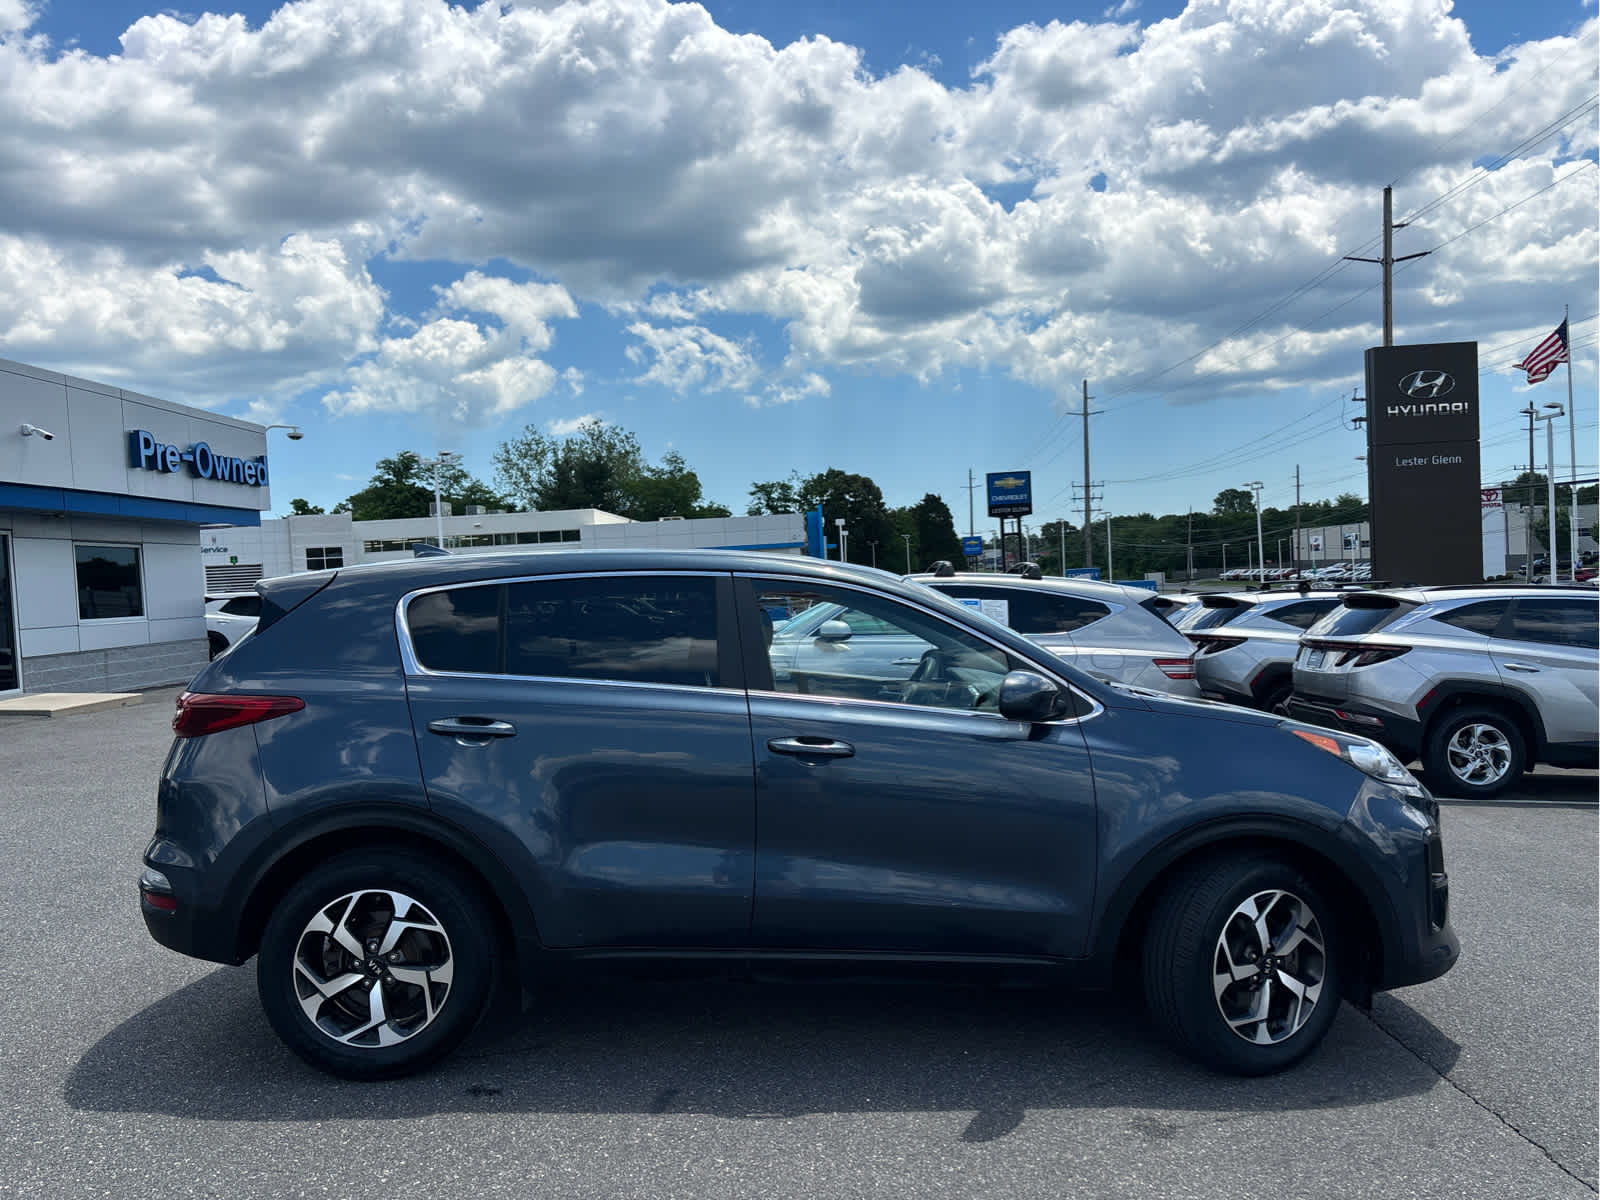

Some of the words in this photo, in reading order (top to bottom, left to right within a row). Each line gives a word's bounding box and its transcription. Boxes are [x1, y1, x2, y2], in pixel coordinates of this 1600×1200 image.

[1387, 402, 1469, 416] HYUNDAI
[129, 430, 269, 486] Pre-Owned
[1396, 455, 1428, 467] Lester
[1431, 455, 1462, 465] Glenn
